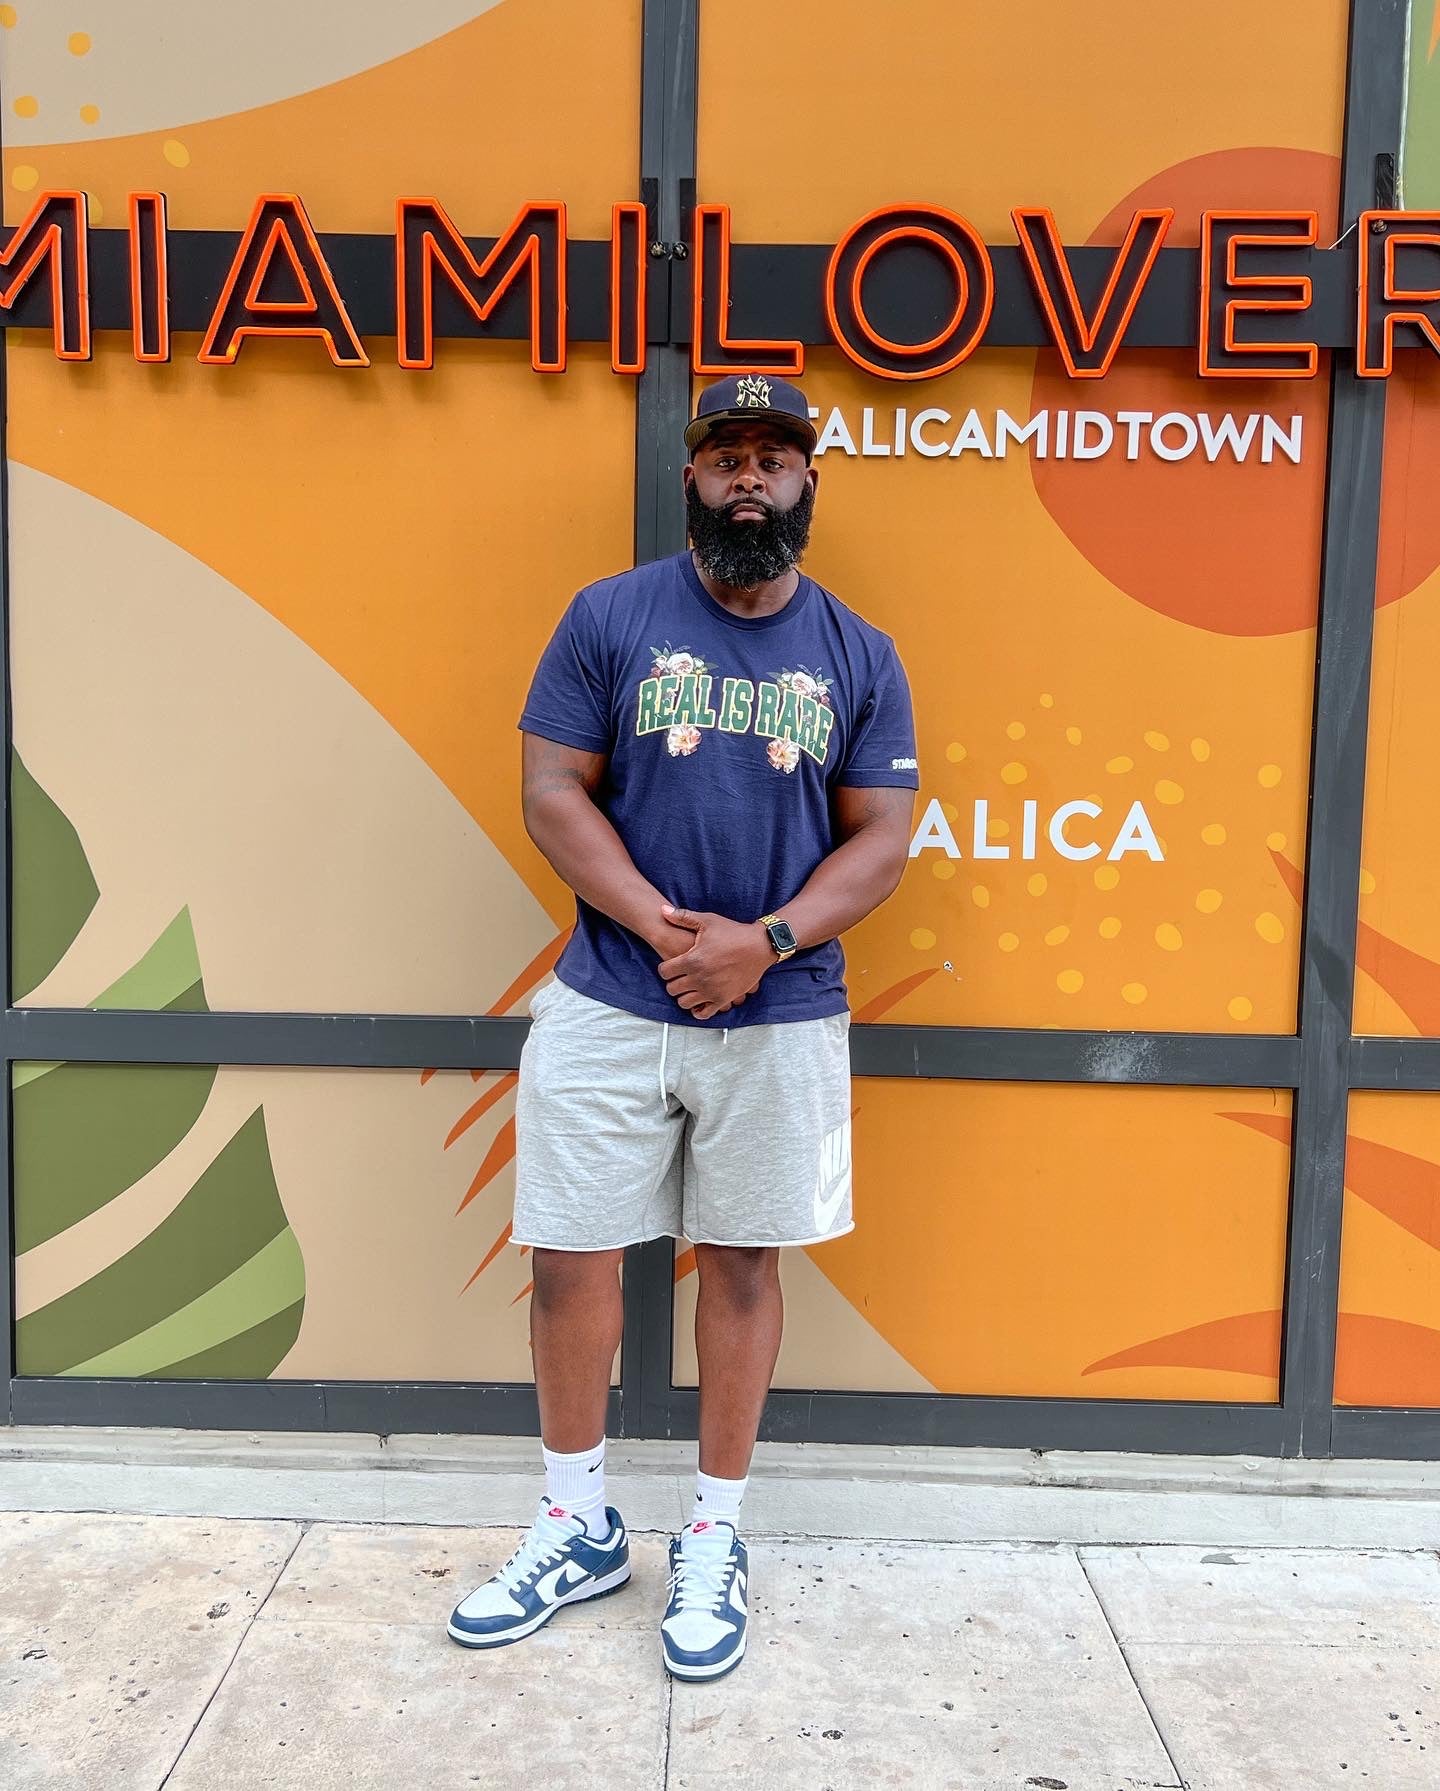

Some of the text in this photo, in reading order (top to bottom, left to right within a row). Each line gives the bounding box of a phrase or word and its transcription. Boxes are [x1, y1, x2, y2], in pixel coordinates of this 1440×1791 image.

[636, 674, 835, 765] REAL IS RARE
[908, 798, 1165, 861] ALICA
